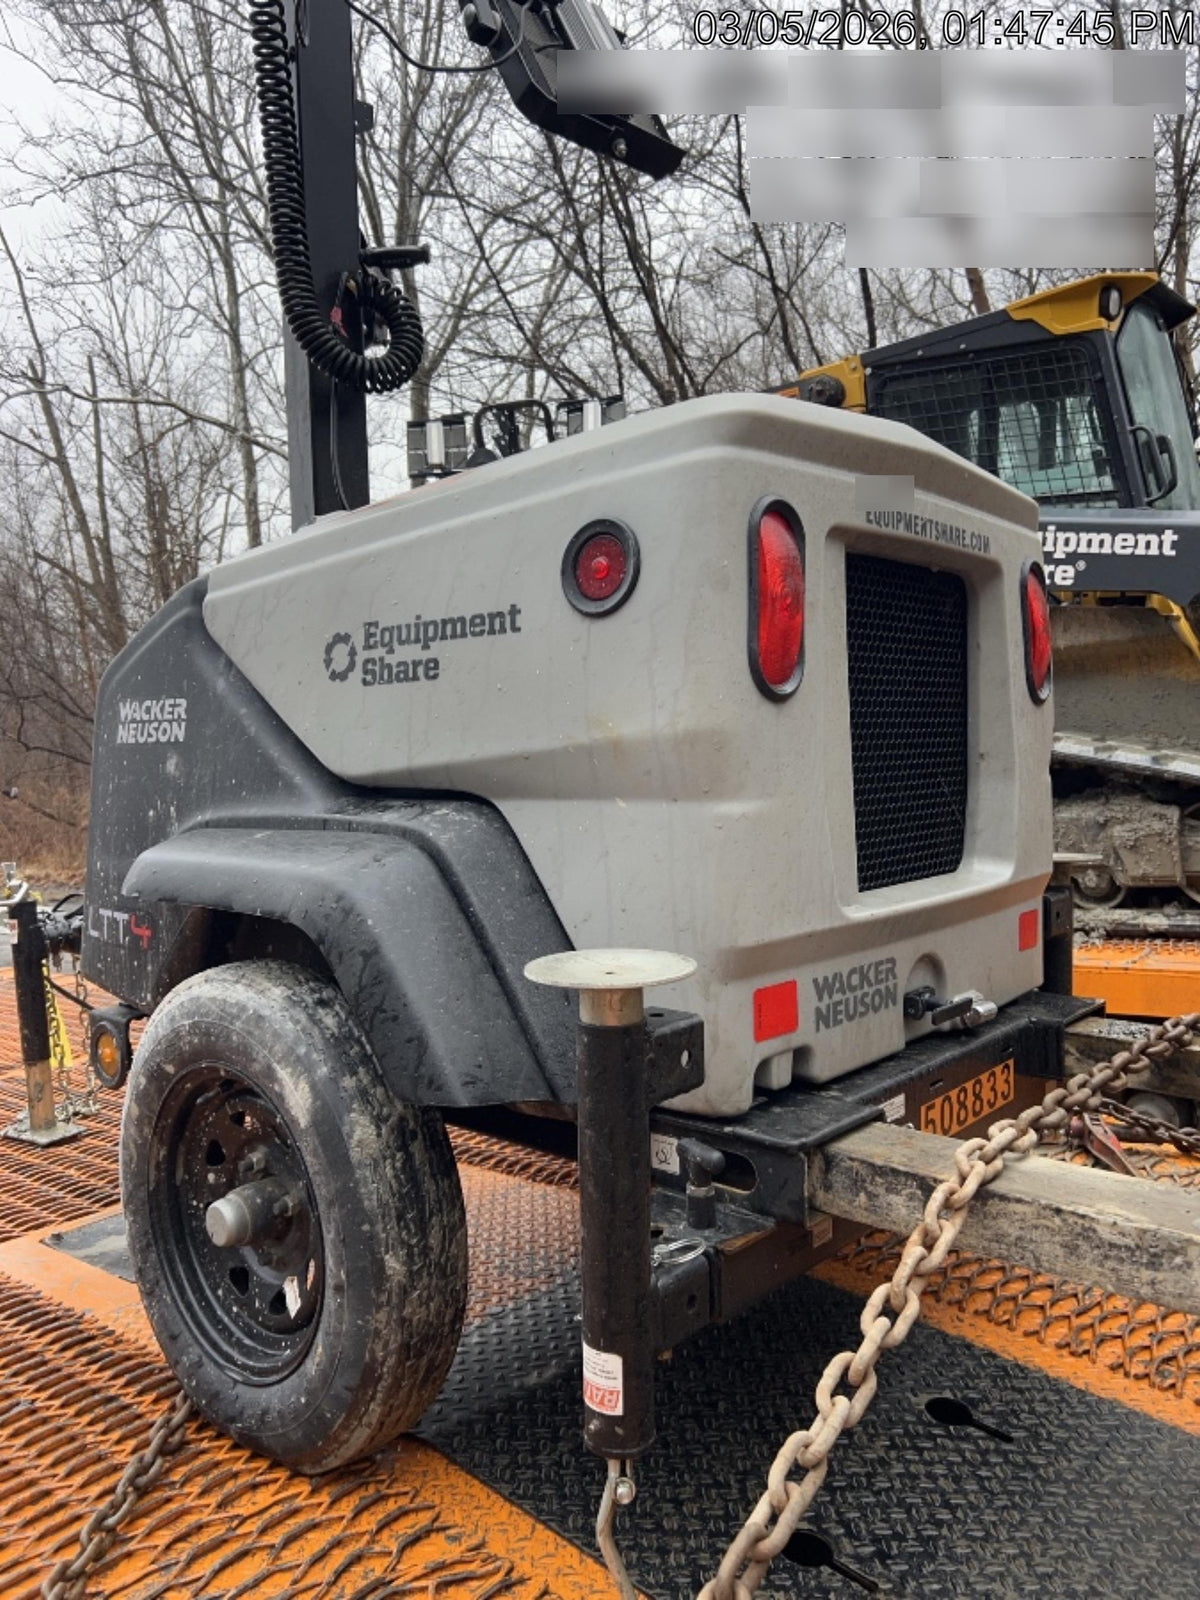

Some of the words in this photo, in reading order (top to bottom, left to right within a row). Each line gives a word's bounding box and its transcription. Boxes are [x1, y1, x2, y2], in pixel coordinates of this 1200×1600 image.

[866, 511, 991, 554] EQUIPMENTSHARE.COM
[361, 603, 522, 655] Equipment
[361, 656, 440, 687] Share
[116, 721, 187, 744] NEUSON
[119, 698, 188, 722] WACKER
[812, 956, 898, 1003] WACKER
[814, 981, 898, 1034] NEUSON
[924, 1062, 1011, 1136] 508833
